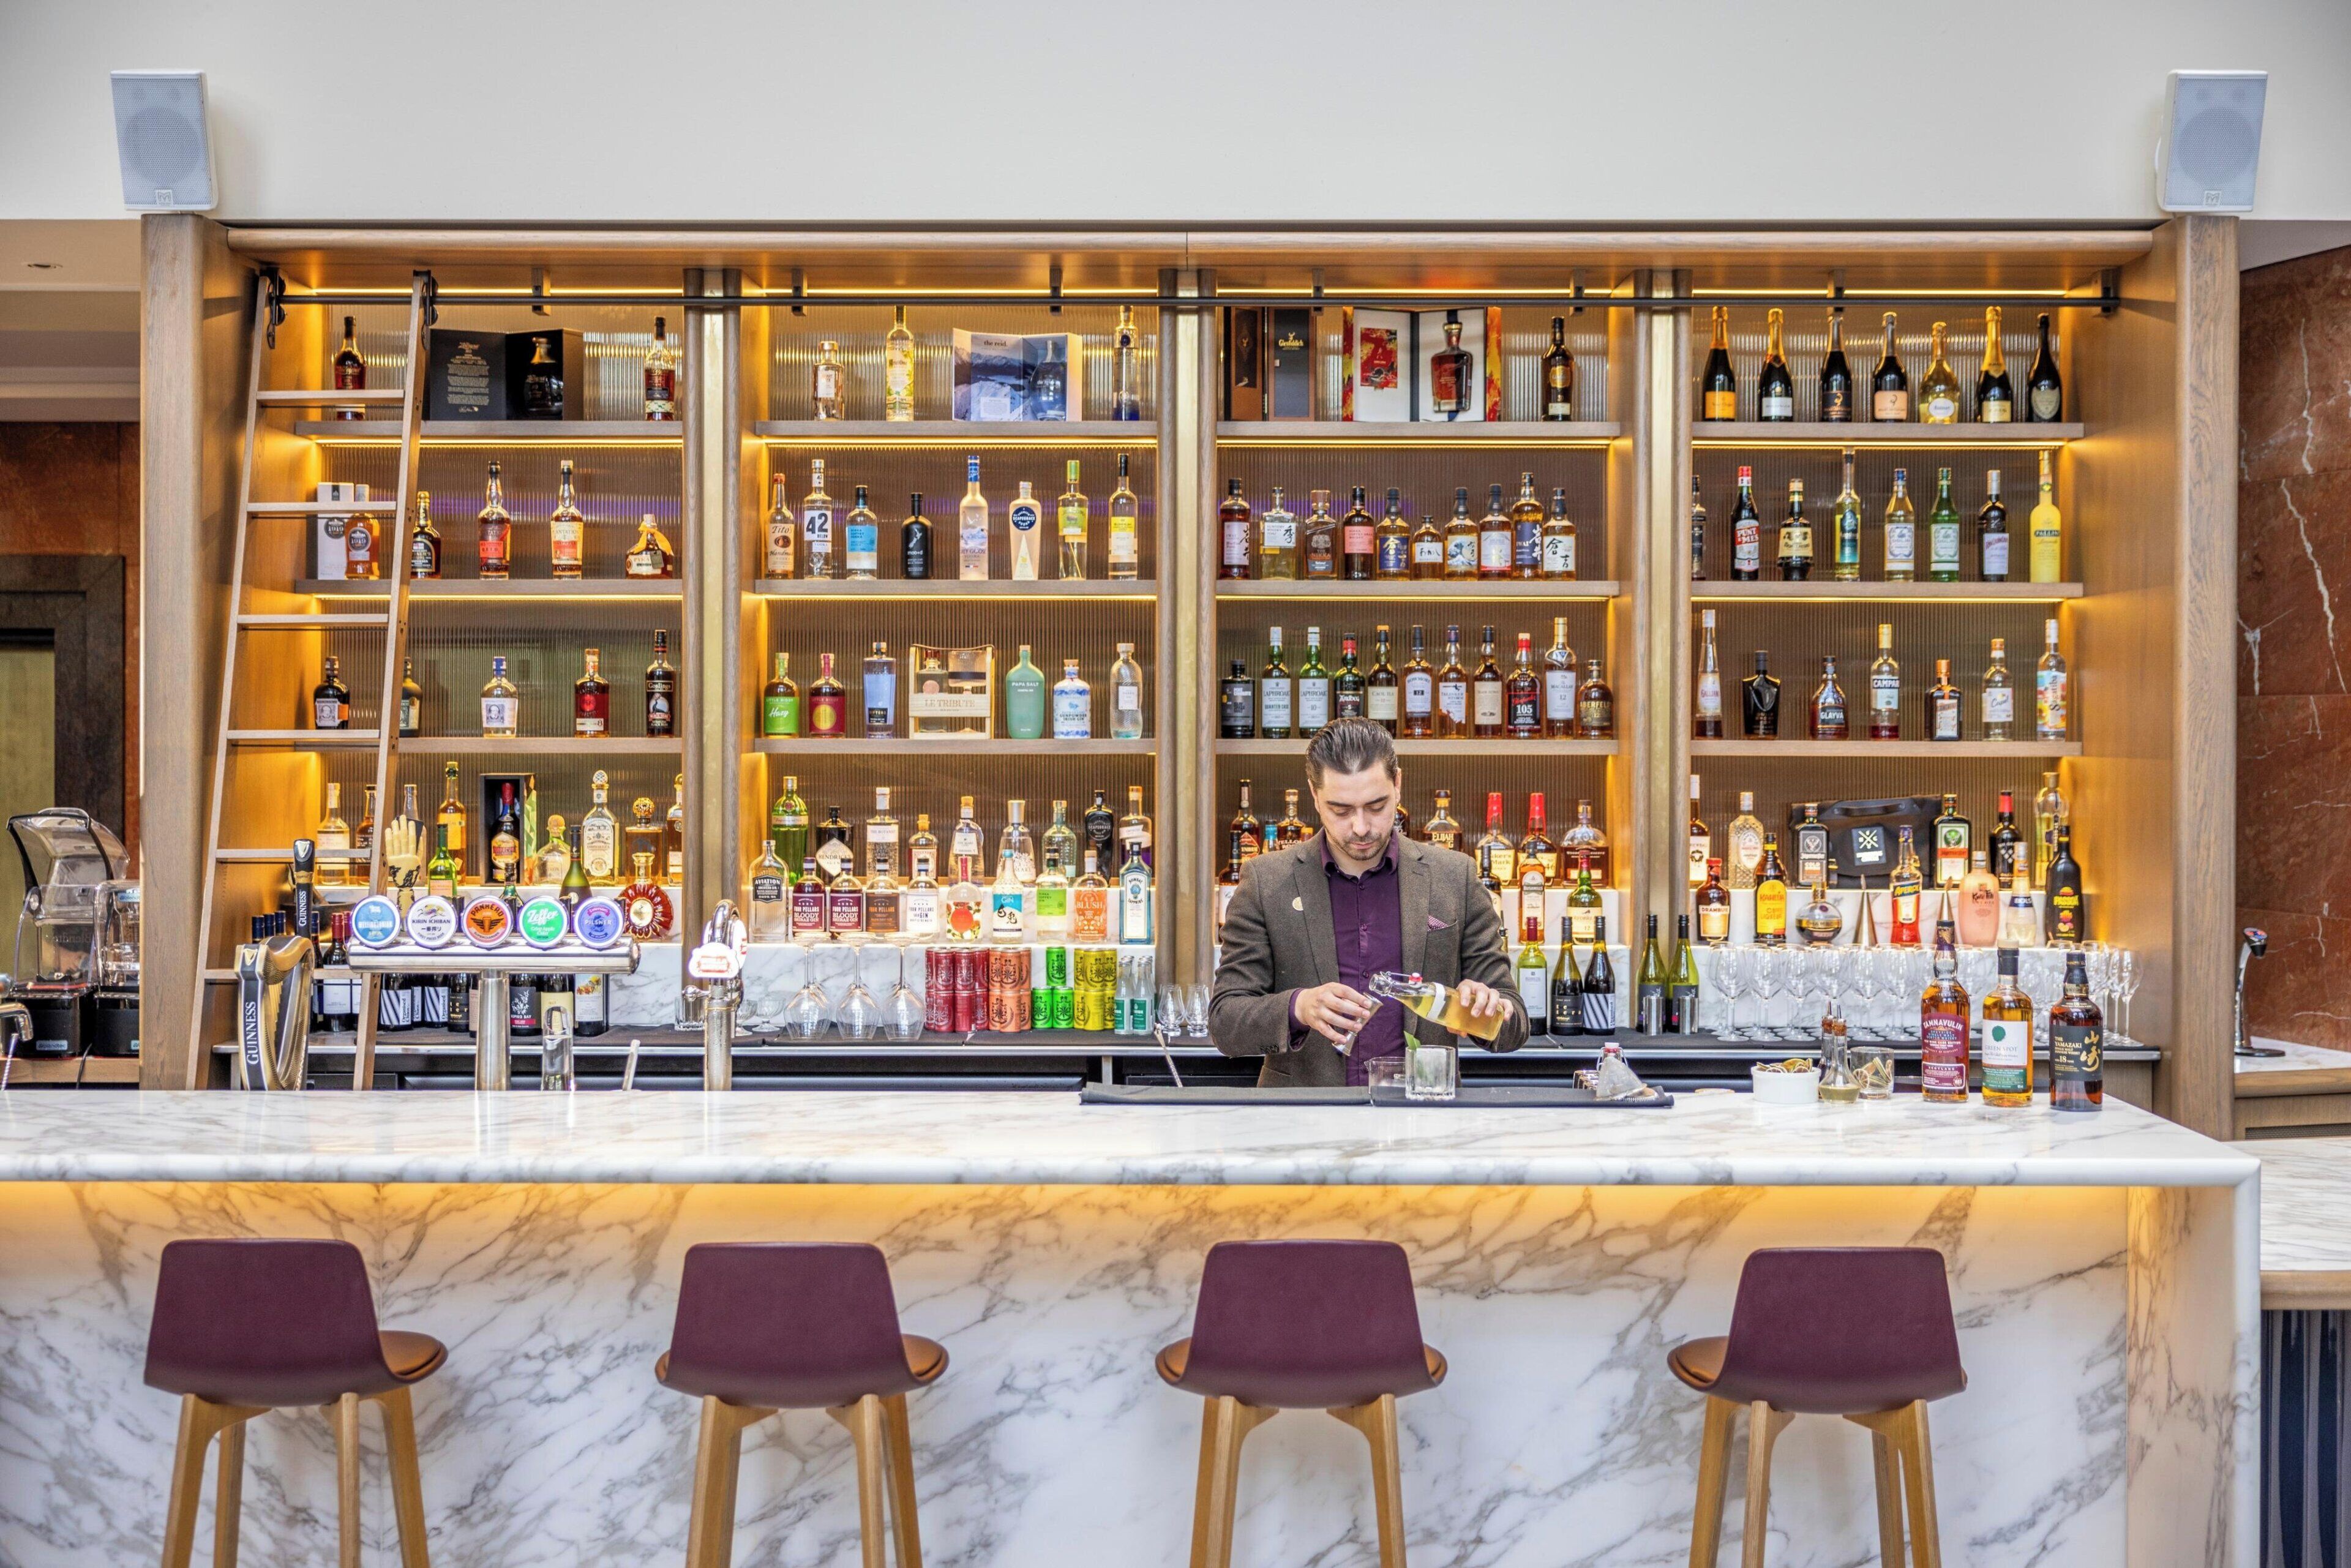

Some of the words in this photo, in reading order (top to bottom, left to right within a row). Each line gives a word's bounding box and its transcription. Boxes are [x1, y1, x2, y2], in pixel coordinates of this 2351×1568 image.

[806, 512, 828, 534] 42
[1737, 527, 1756, 536] PUNT
[1742, 535, 1758, 544] MES
[648, 682, 671, 691] Goslings
[1873, 680, 1900, 688] CAMPAR
[937, 699, 975, 708] TRIBUTE
[768, 707, 789, 718] Hazy
[1516, 705, 1533, 714] 105
[1894, 884, 1920, 896] APEROL
[471, 904, 504, 917] PANHEAD
[527, 909, 560, 926] Zeffer
[1923, 1019, 1963, 1031] TAMNAVULIN
[245, 1001, 259, 1065] GUINNESS
[2080, 1030, 2099, 1072] 山崎
